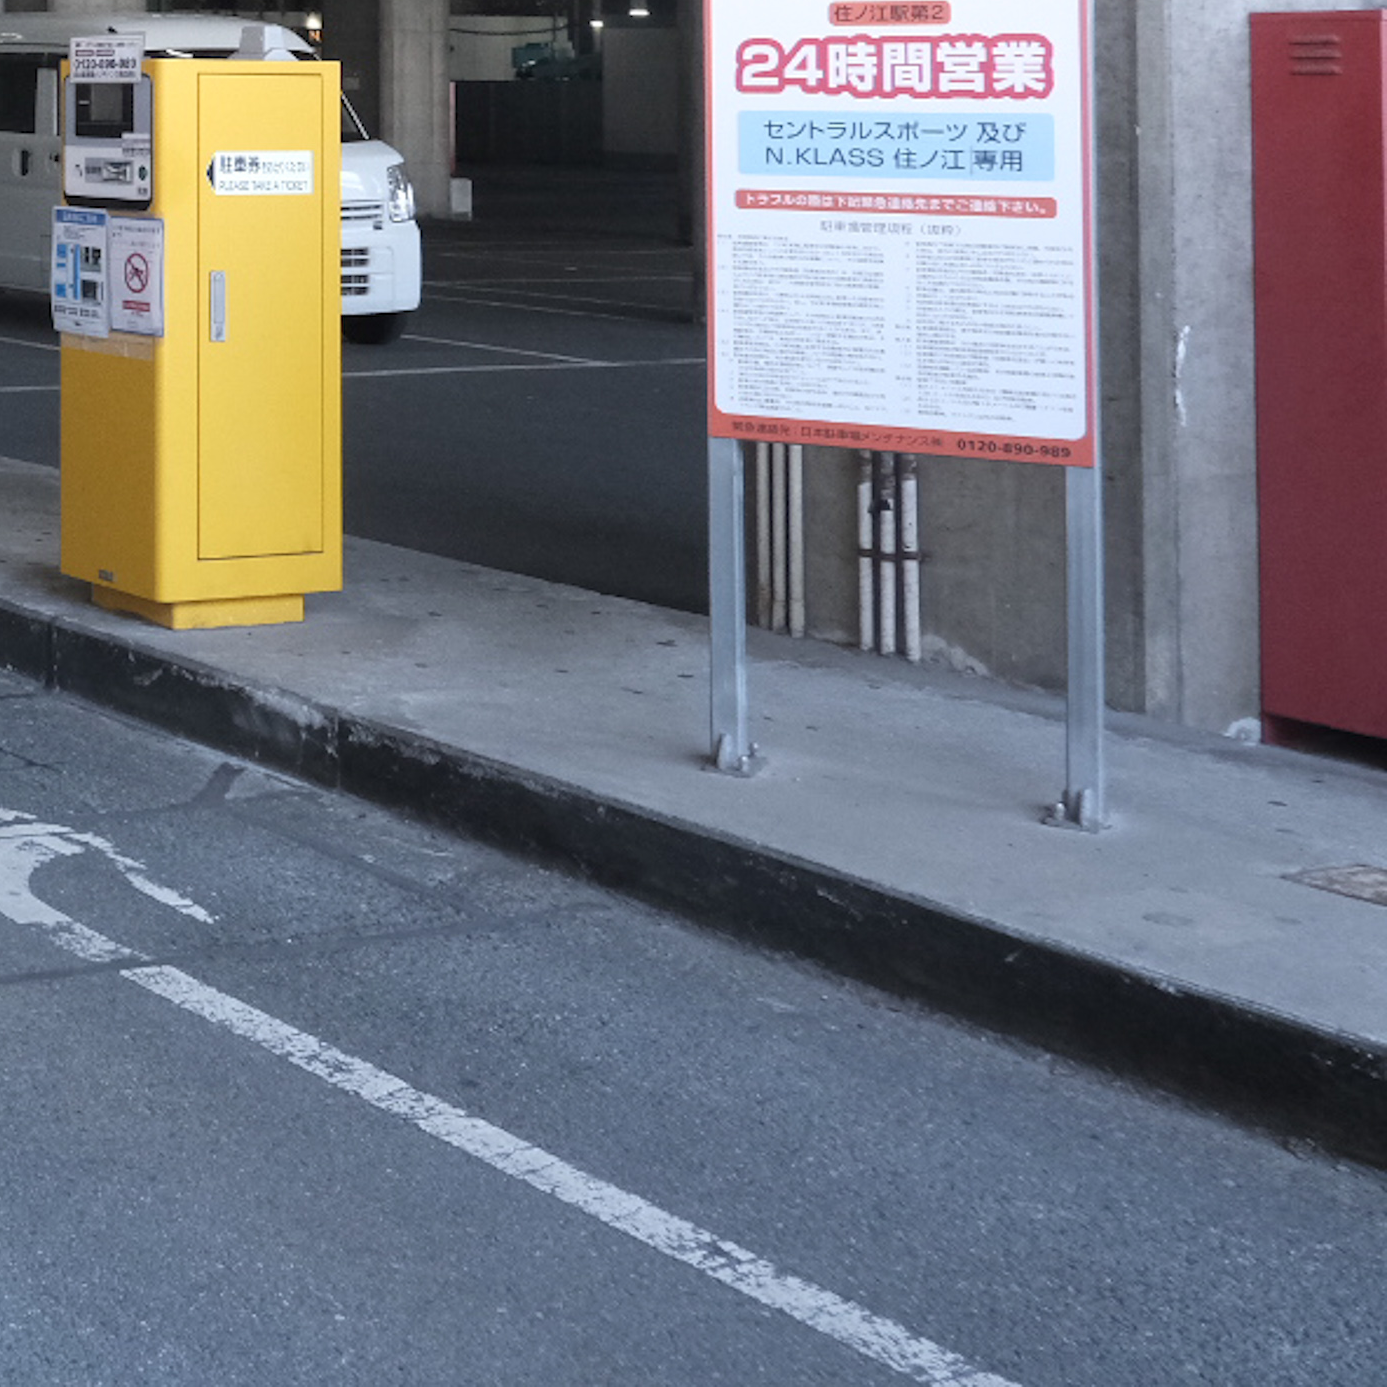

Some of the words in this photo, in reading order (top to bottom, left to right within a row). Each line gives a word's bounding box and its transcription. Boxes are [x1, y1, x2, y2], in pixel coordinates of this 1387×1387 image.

[834, 4, 945, 23] 住ノ江駅第2
[737, 37, 1050, 96] 24時間営業
[764, 119, 967, 143] セントラルスポーツ
[976, 121, 1026, 144] 及び
[765, 147, 884, 168] N.KLASS
